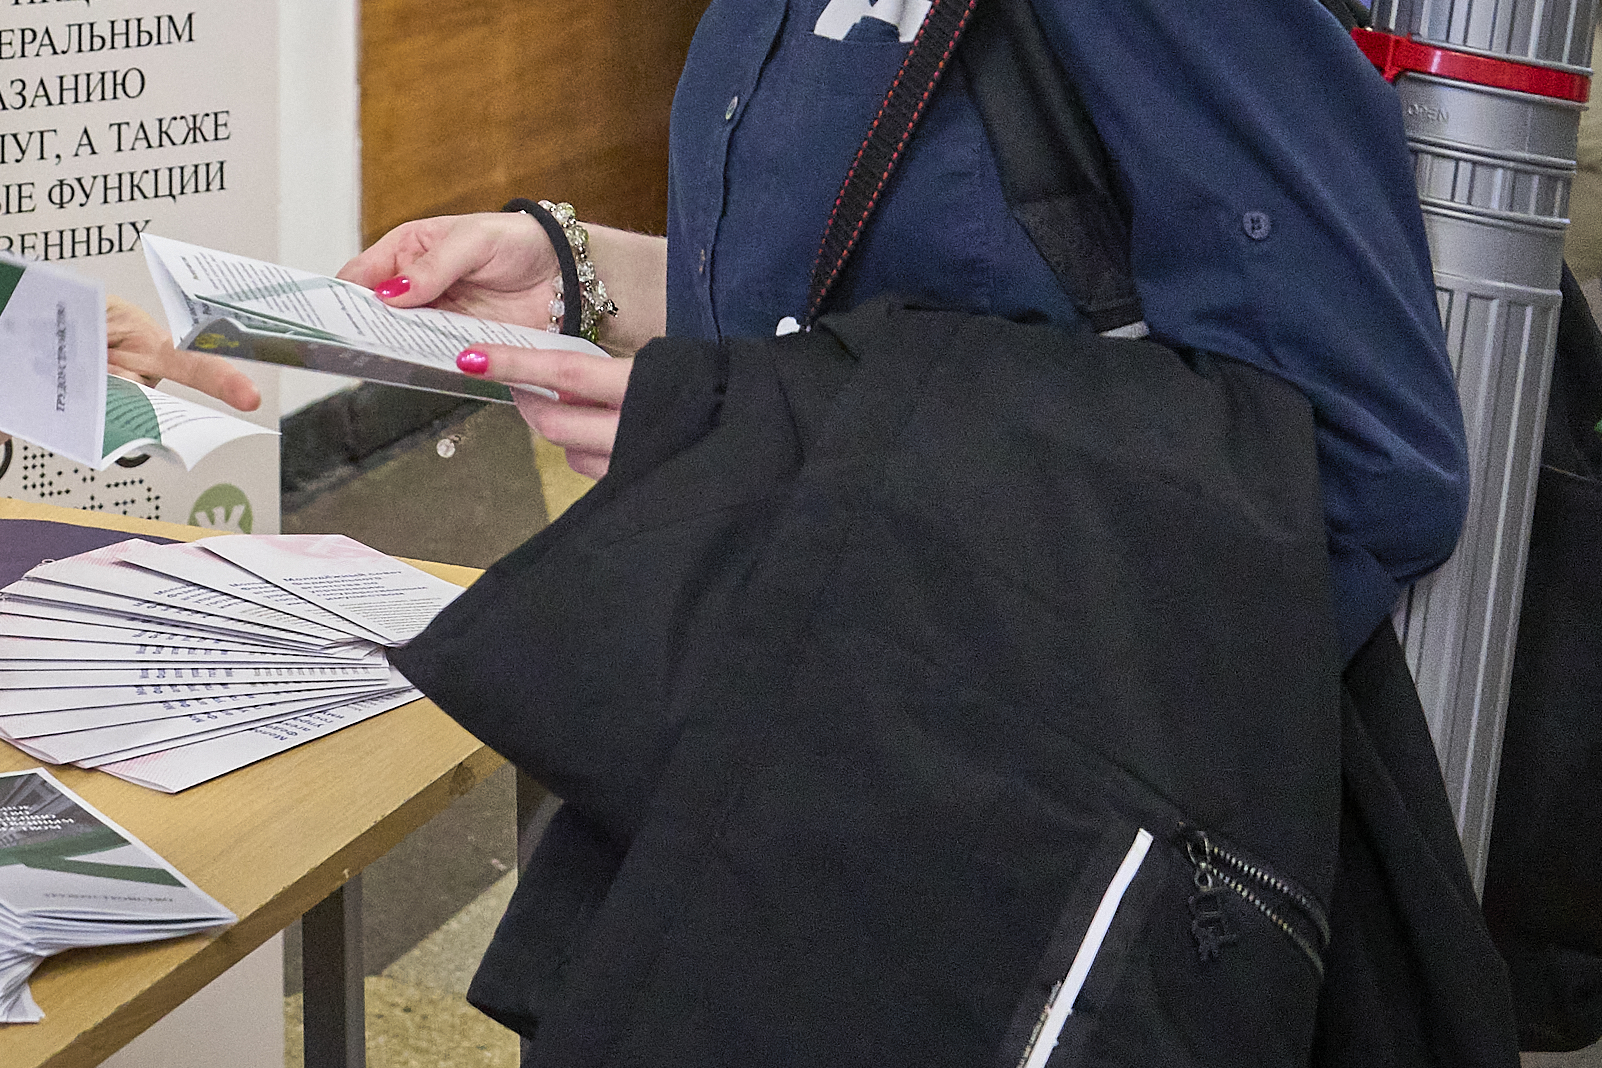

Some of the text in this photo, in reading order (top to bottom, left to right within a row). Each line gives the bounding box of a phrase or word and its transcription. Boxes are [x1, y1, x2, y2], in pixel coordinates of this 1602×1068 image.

[72, 126, 98, 158] А
[109, 110, 231, 154] ТАКЖЕ
[48, 160, 228, 210] ФУНКЦИИ
